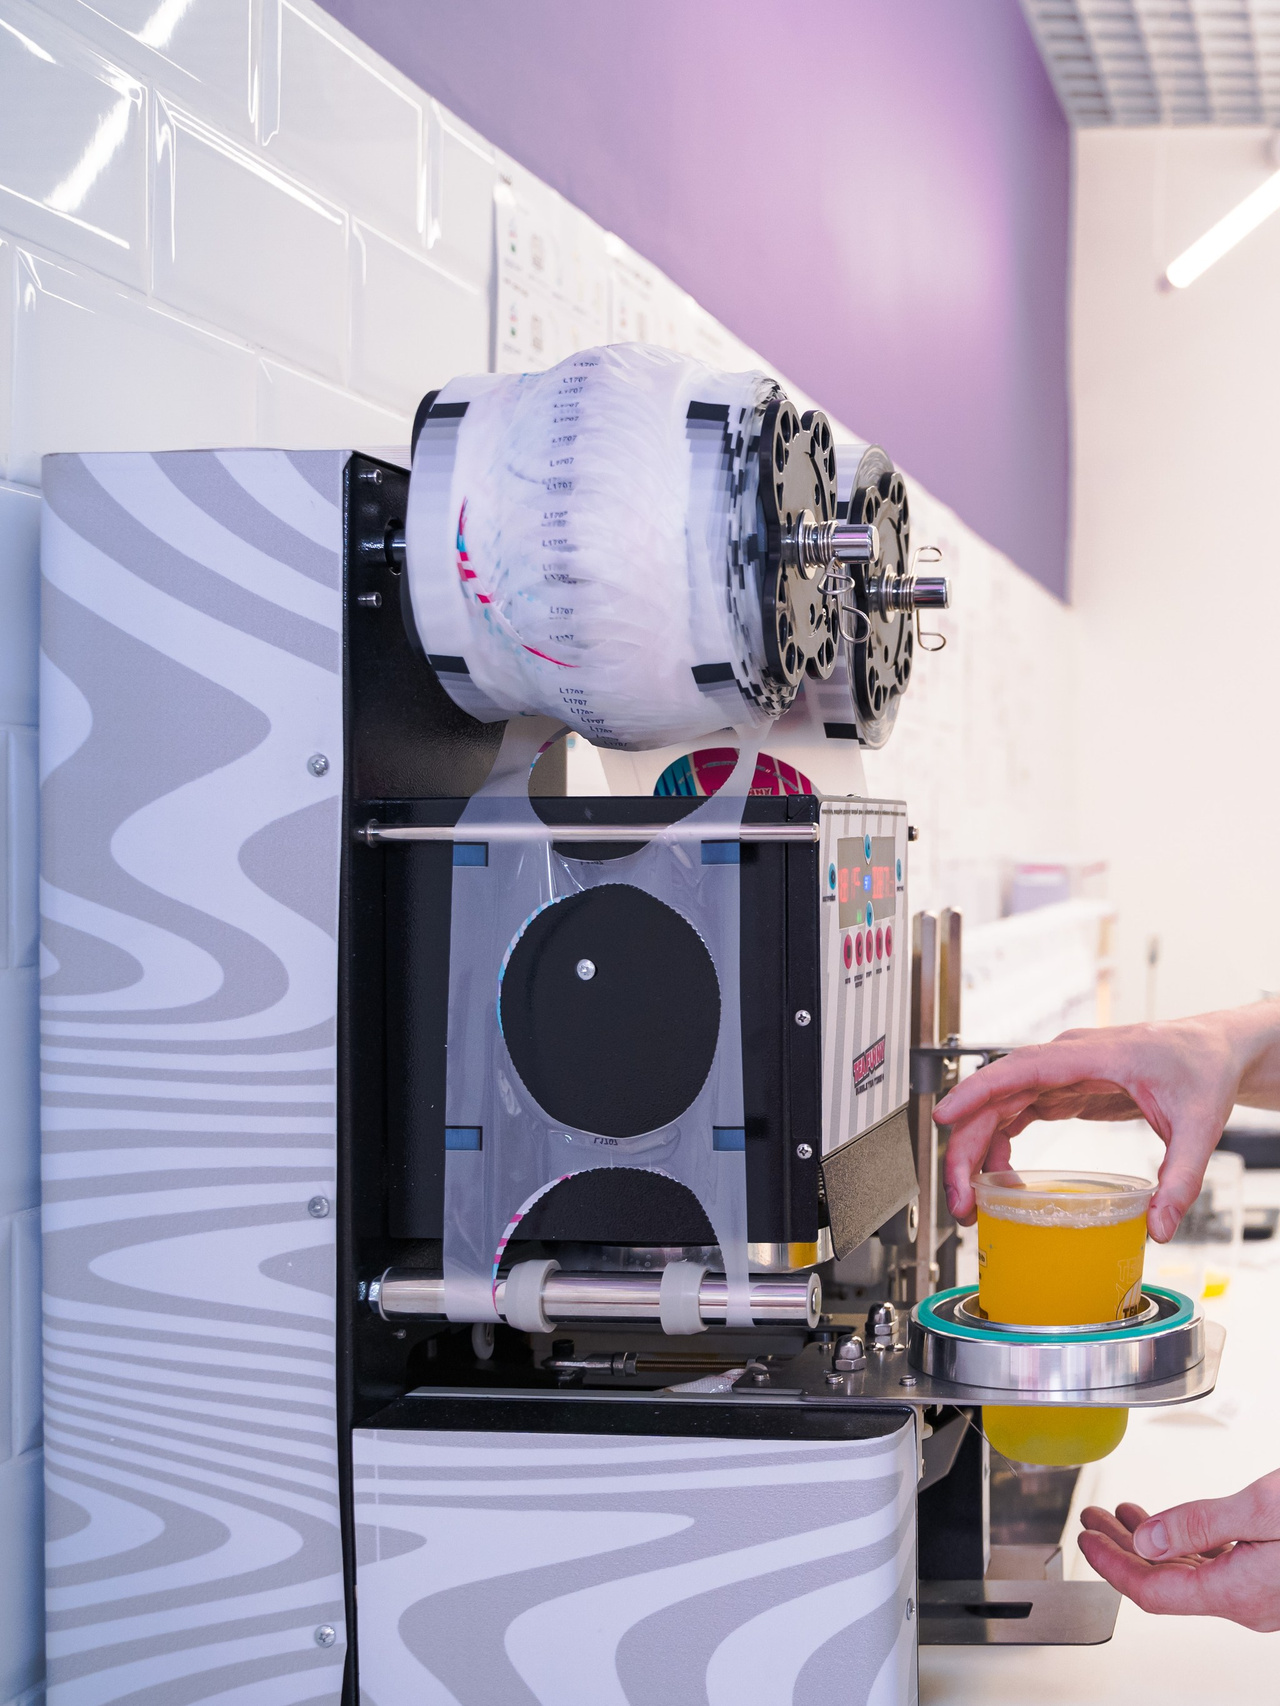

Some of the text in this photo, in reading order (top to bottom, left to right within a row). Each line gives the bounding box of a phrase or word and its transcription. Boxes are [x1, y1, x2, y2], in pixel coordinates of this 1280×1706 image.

[547, 481, 573, 491] L1707
[550, 606, 574, 615] L1707
[563, 697, 588, 706] L1707
